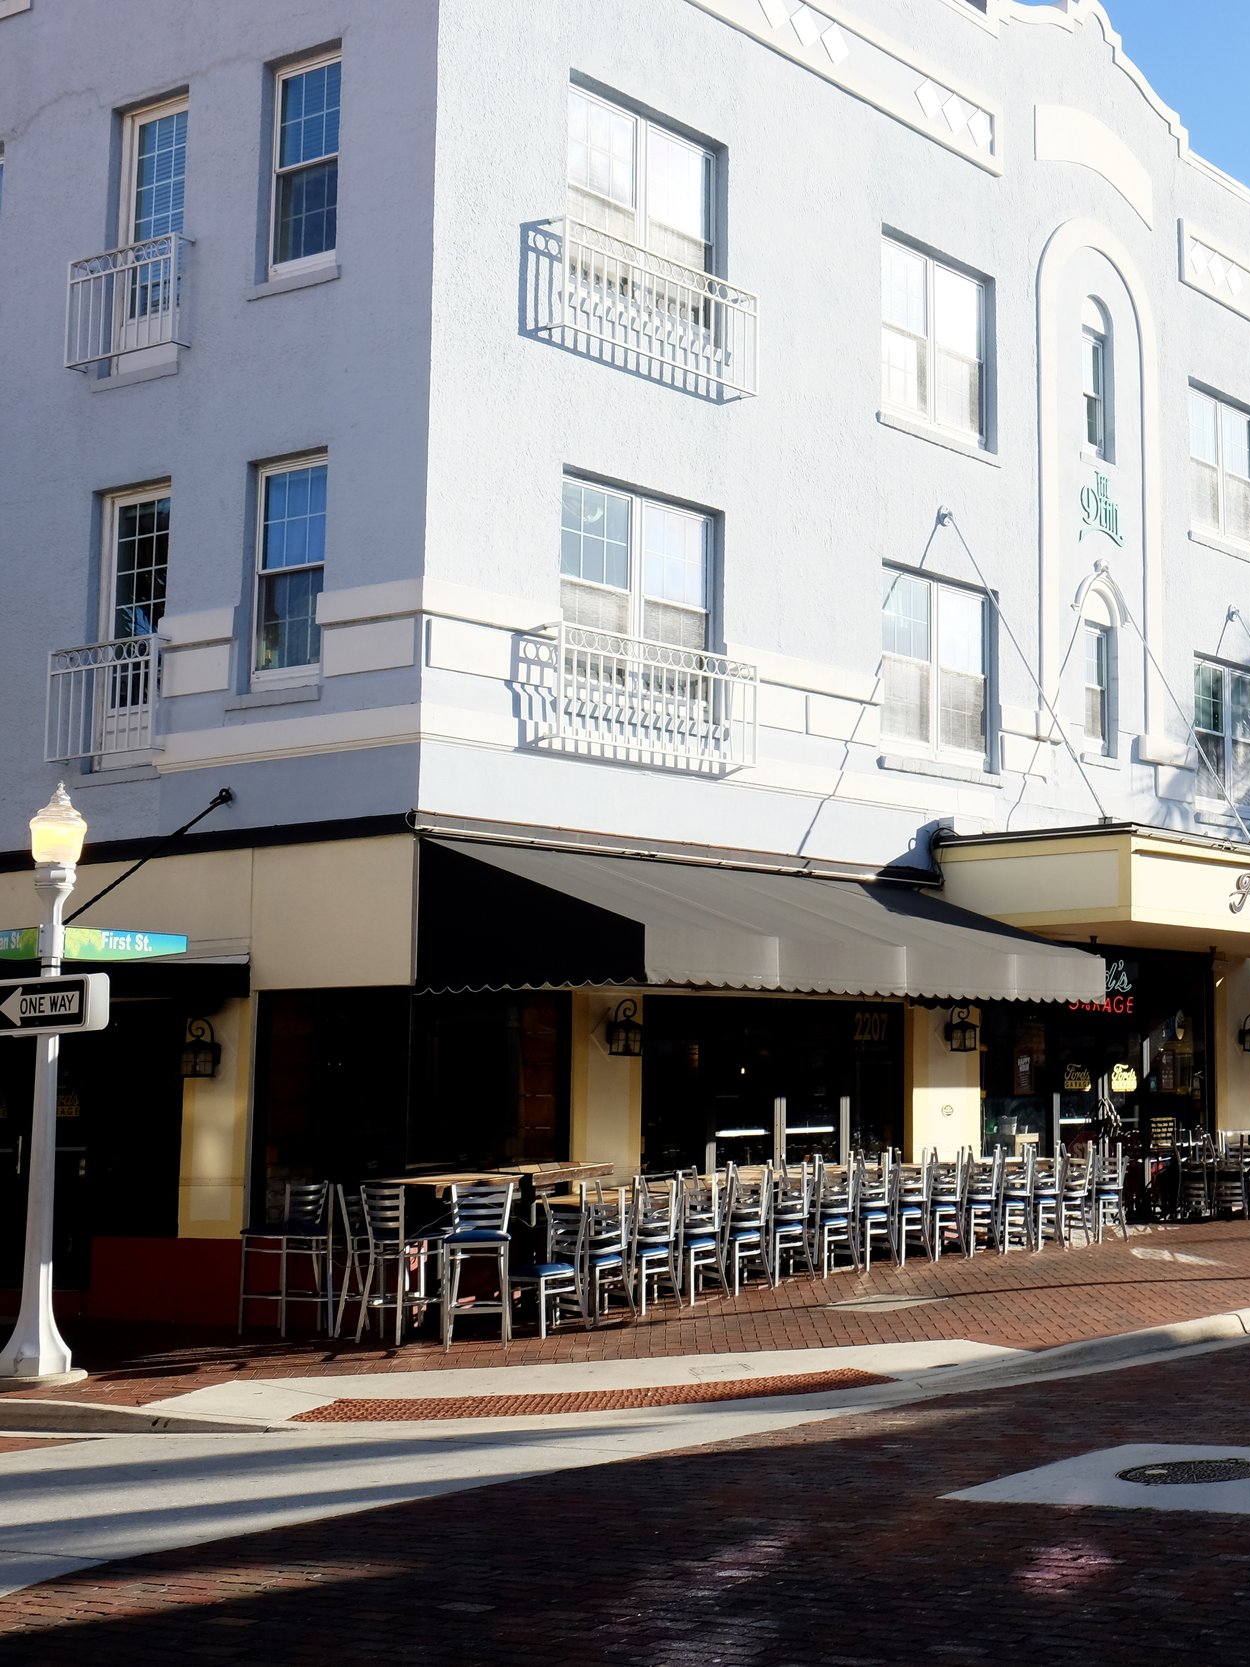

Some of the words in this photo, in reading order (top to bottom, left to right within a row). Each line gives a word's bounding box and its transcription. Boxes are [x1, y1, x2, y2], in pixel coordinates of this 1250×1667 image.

[0, 937, 9, 951] an
[101, 931, 131, 951] First
[135, 932, 152, 952] St.
[1105, 959, 1133, 993] d's
[20, 995, 46, 1015] ONE
[49, 993, 75, 1014] WAY
[1068, 996, 1135, 1014] AGE
[853, 1011, 889, 1042] 2207
